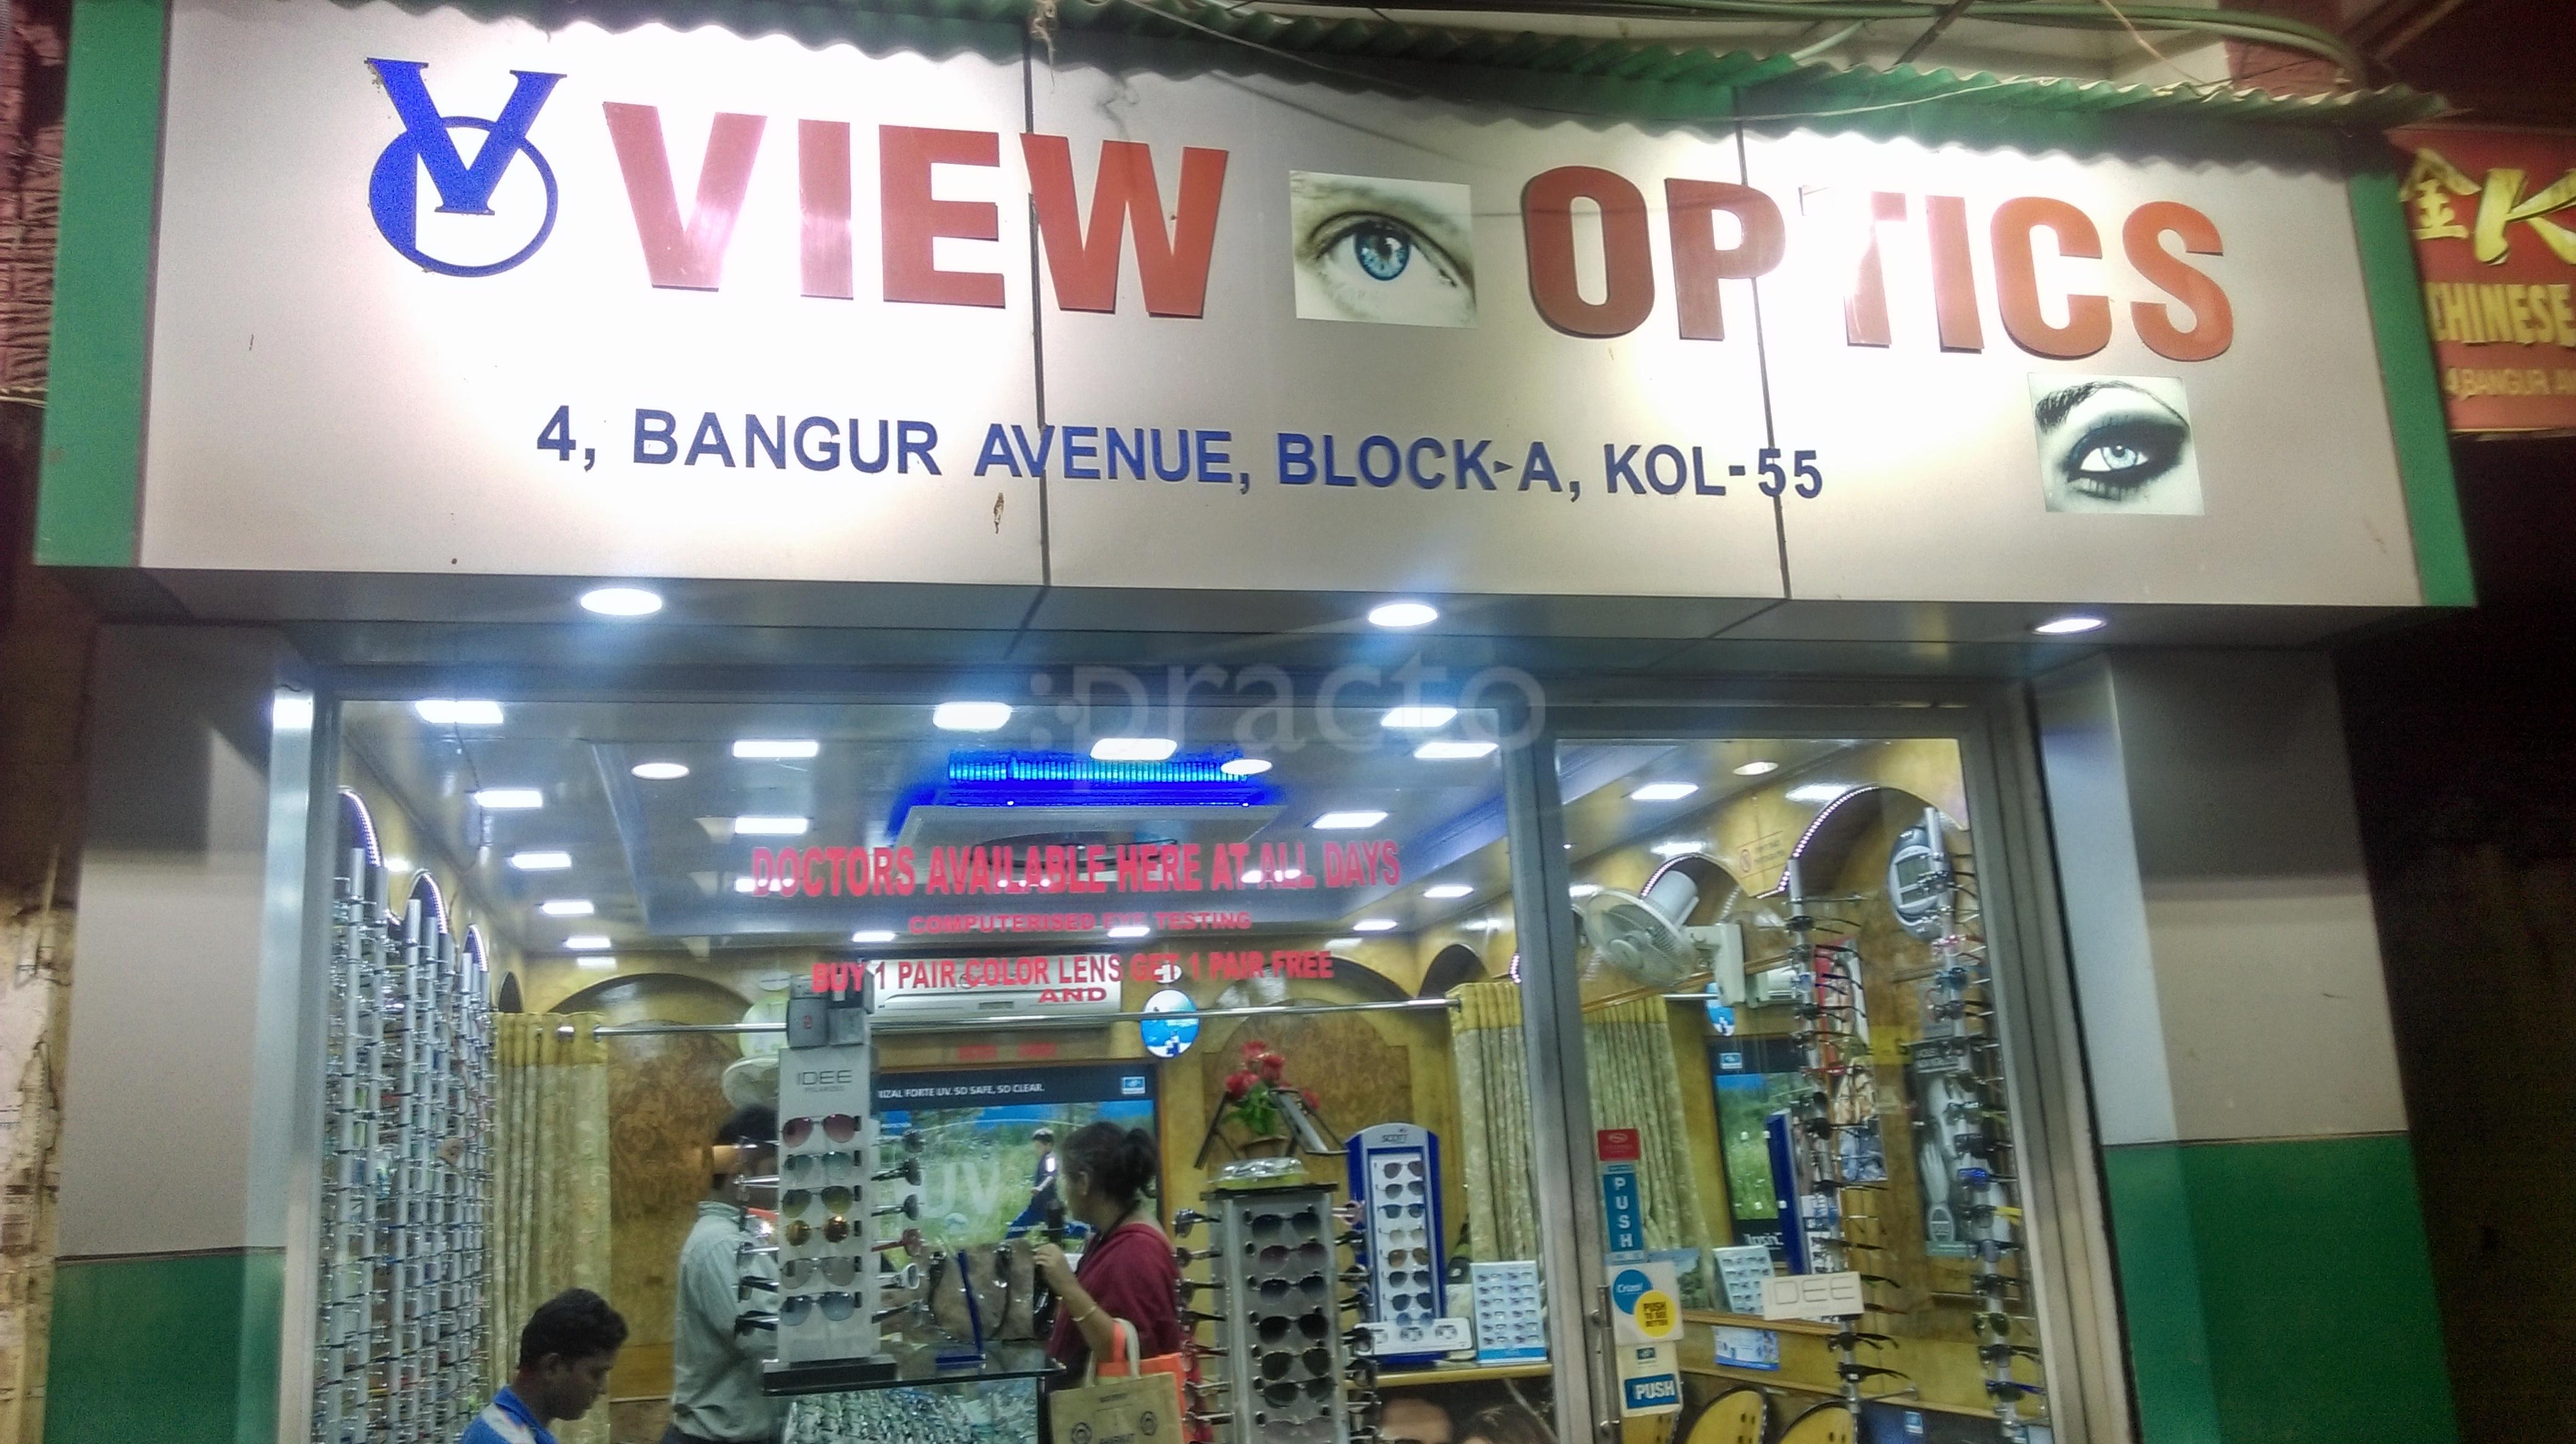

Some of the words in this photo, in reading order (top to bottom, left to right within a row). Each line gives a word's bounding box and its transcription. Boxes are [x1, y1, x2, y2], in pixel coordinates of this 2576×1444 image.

[602, 101, 1228, 318] VIEW
[1524, 165, 2234, 362] OPTICS
[2424, 282, 2576, 346] CHINESE
[537, 404, 597, 472] 4,
[632, 407, 941, 476] BANGUR
[976, 424, 1249, 494] AVENUE,
[1277, 432, 1581, 502] BLOCK-A,
[1603, 443, 1823, 499] KOL-55
[753, 846, 914, 898] DOCTORS
[926, 845, 1106, 895] AVAILABLE
[1117, 843, 1203, 892] HERE
[1211, 843, 1250, 891] AT
[1259, 842, 1315, 889] ALL
[1324, 839, 1401, 887] DAYS
[908, 913, 1096, 934] COMPUTERISED
[1154, 911, 1251, 931] TESTING
[812, 962, 867, 993] BUY
[875, 962, 886, 990] 1
[898, 960, 956, 990] PAIR
[964, 957, 1050, 988] COLOR
[1059, 954, 1123, 984] LENS
[1130, 953, 1180, 982] GET
[1190, 952, 1200, 981] 1
[1209, 951, 1265, 981] PAIR
[1272, 950, 1334, 980] FREE
[1038, 988, 1107, 1003] AND
[796, 1070, 853, 1086] IDEE
[905, 1087, 934, 1098] FORTE
[954, 1085, 968, 1095] SO
[997, 1084, 1011, 1093] SO
[1613, 1176, 1634, 1248] PUSH
[1644, 1301, 1667, 1312] PUSH
[1634, 1380, 1676, 1400] PUSH
